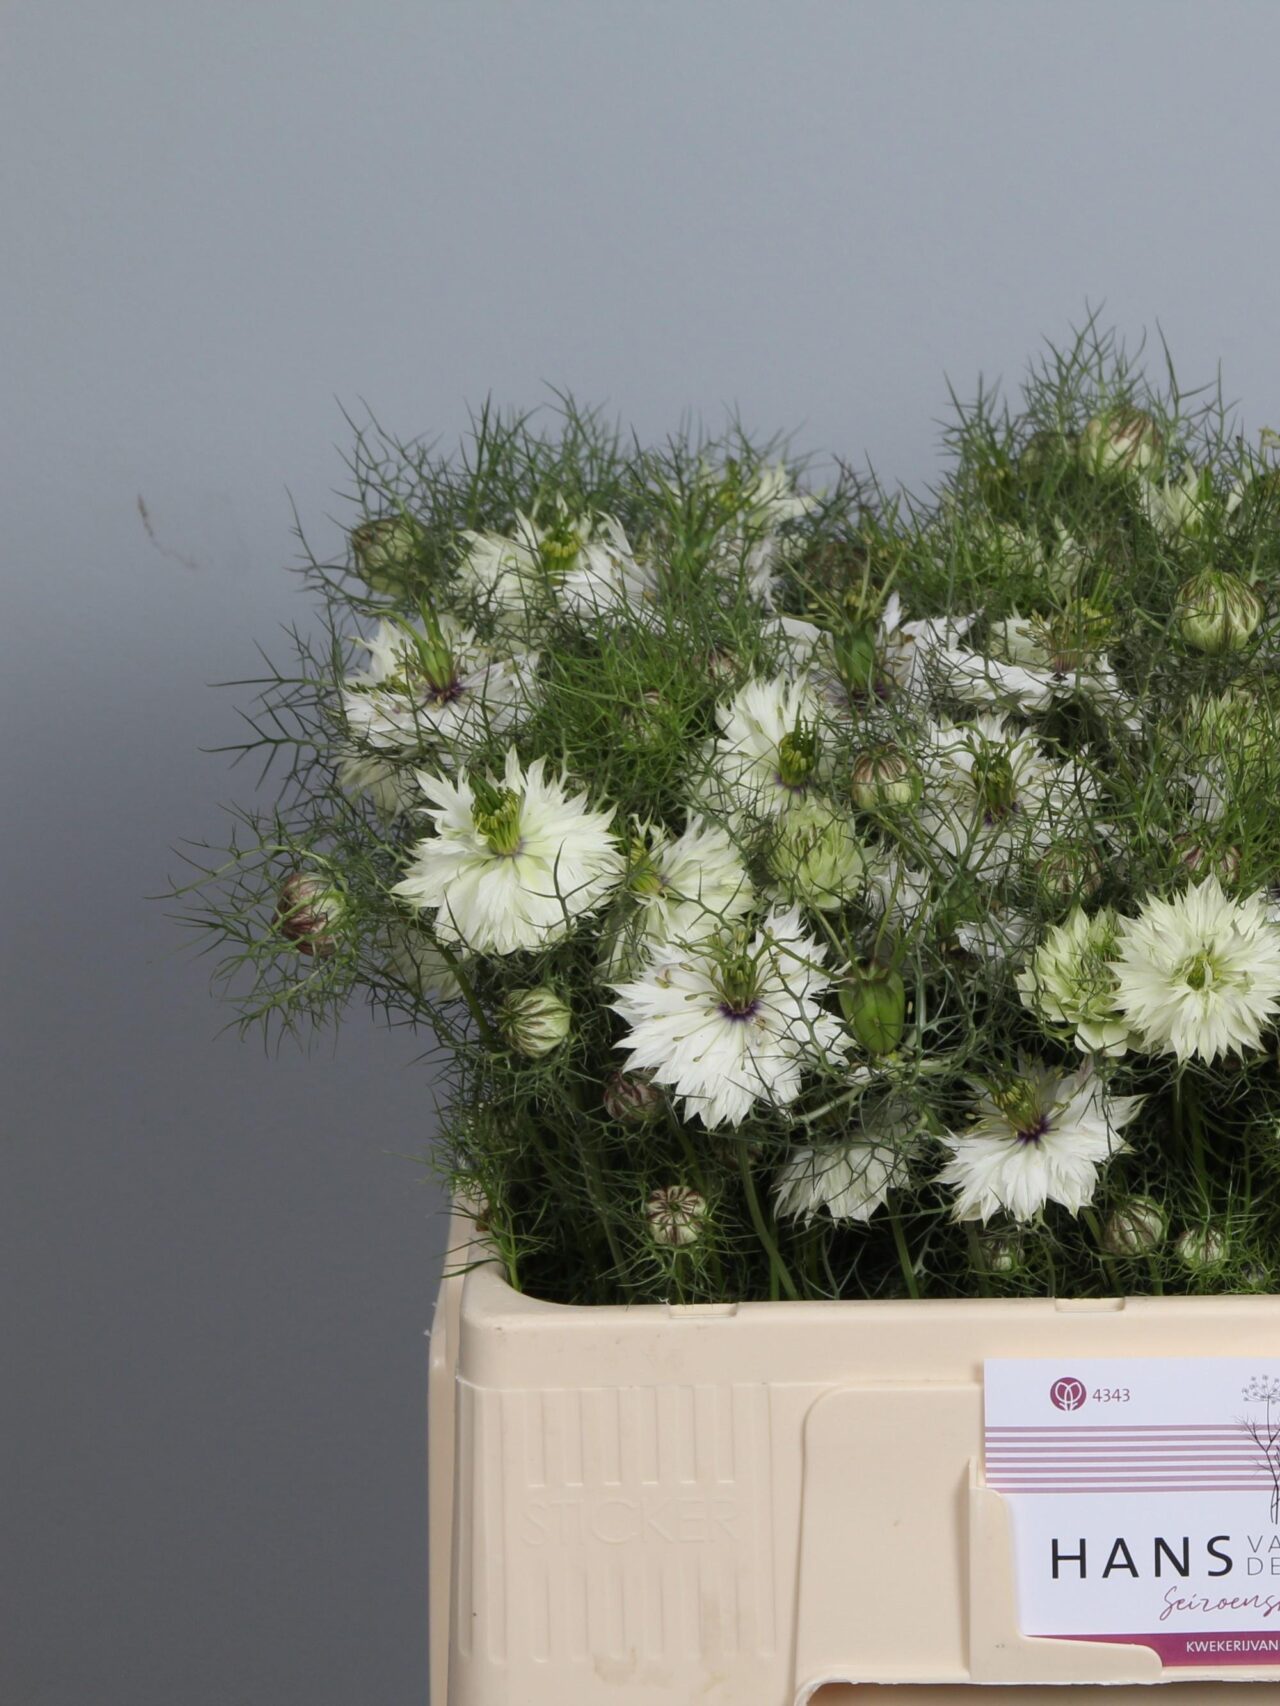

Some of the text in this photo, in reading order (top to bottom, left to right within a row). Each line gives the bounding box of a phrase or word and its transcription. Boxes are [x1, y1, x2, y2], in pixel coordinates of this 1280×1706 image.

[1092, 1388, 1131, 1403] 4343
[521, 1497, 742, 1547] STICKER
[1051, 1535, 1234, 1579] HANS
